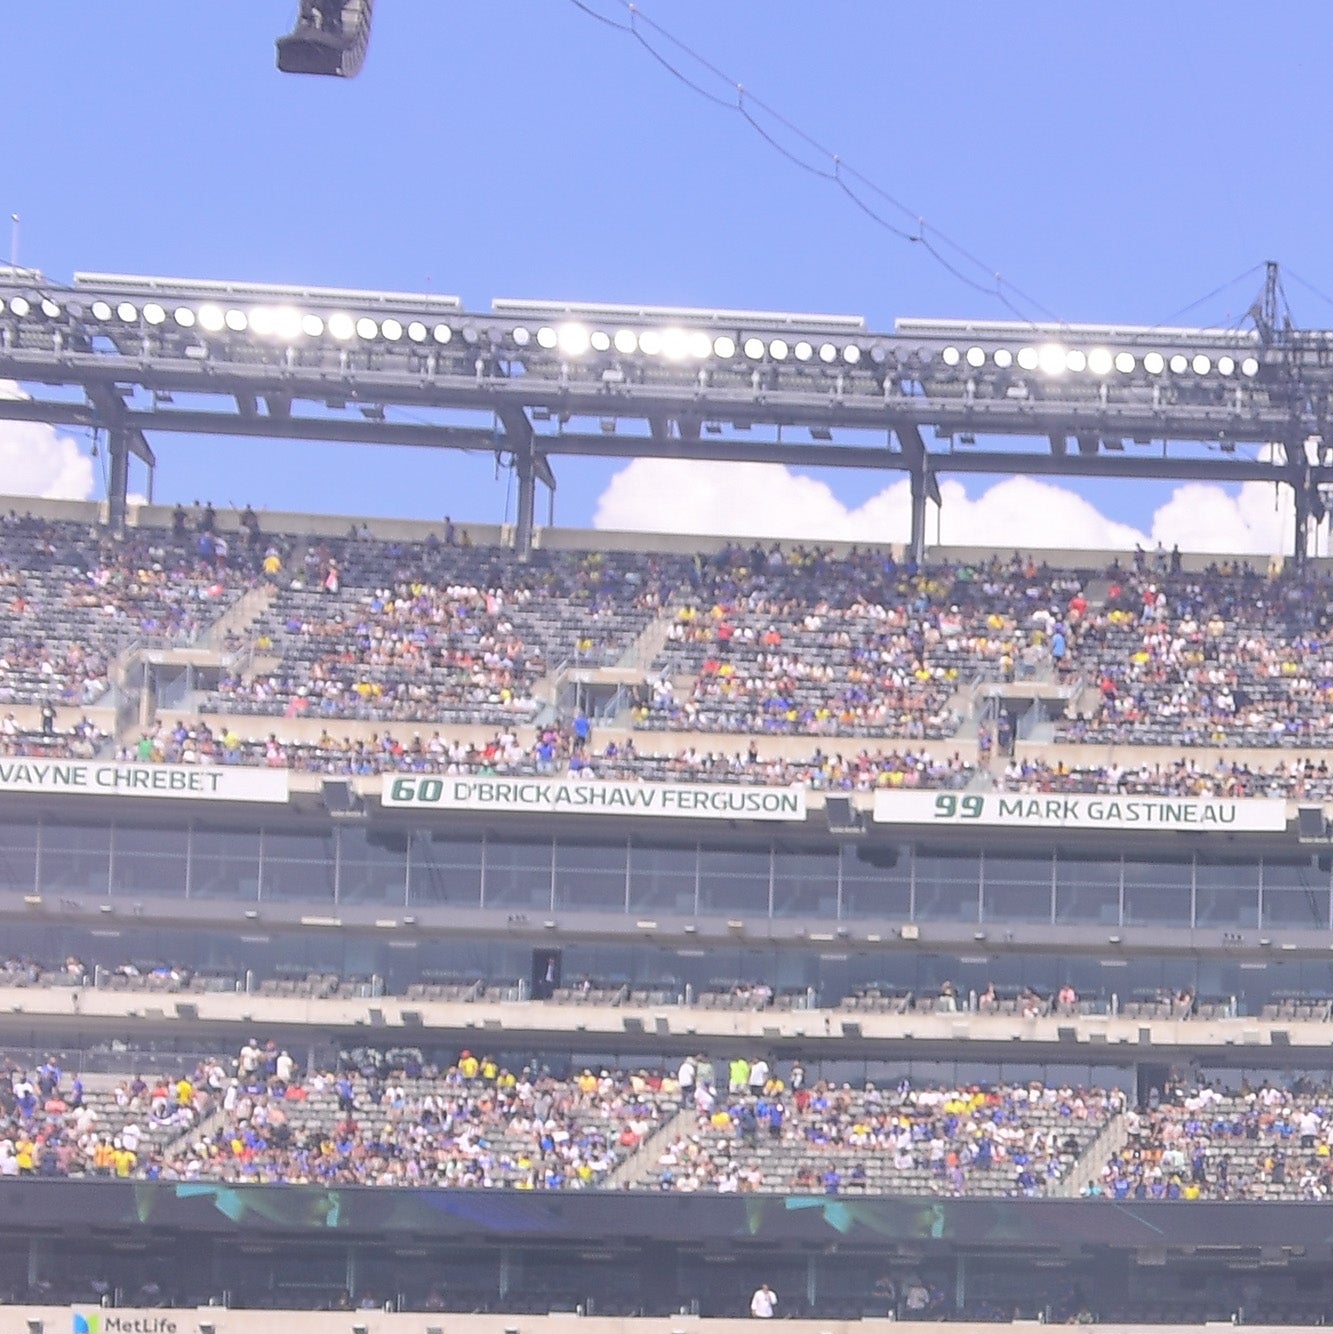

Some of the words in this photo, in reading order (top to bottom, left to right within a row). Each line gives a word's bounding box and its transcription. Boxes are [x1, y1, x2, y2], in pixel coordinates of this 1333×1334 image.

[96, 767, 223, 791] CHREBET
[391, 778, 444, 802] 60
[453, 782, 655, 808] D'BRICKASHAW
[662, 789, 799, 812] FERGUSON
[934, 794, 984, 819] 99
[999, 799, 1080, 820] MARK
[1088, 801, 1236, 824] GASTINEAU
[105, 1317, 177, 1333] MetLife
